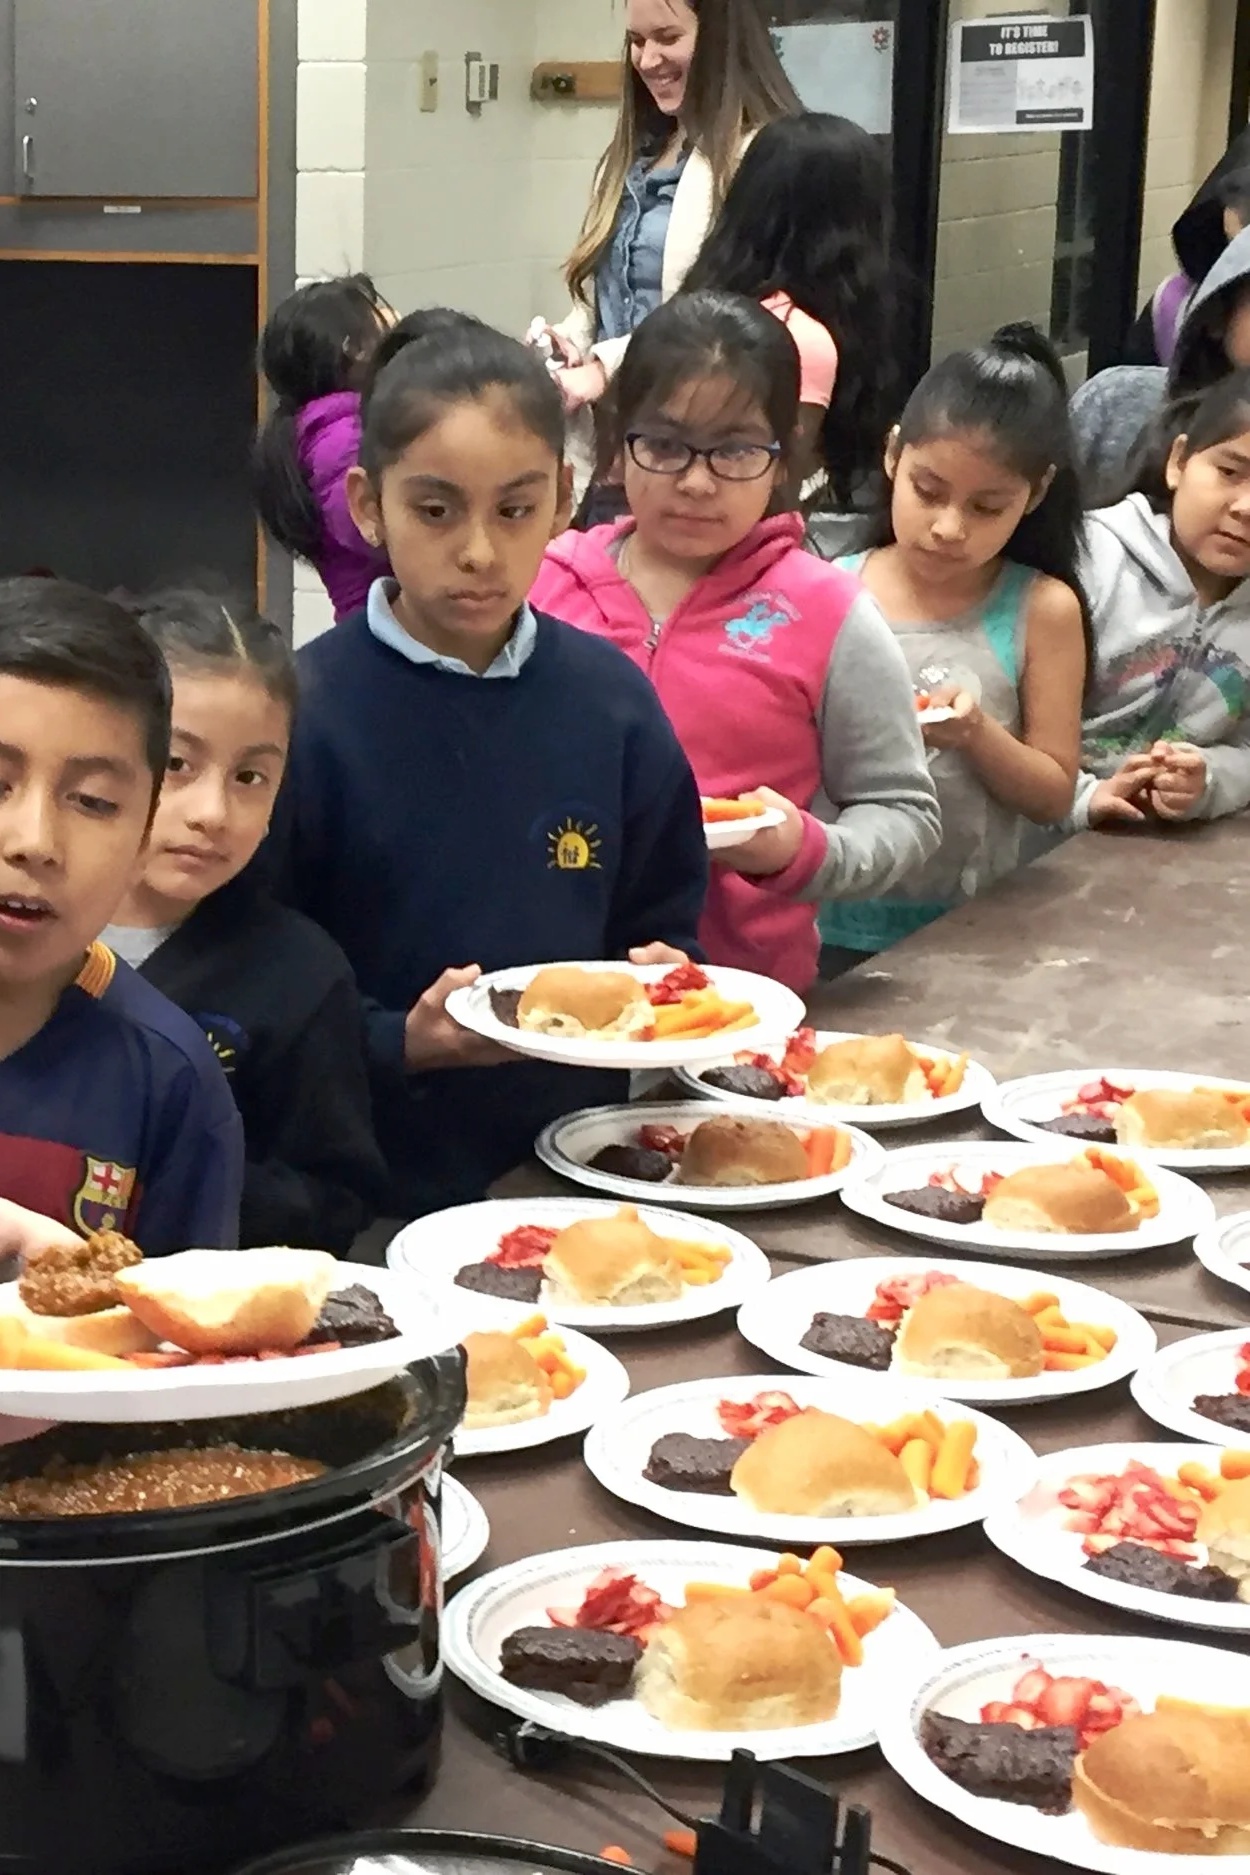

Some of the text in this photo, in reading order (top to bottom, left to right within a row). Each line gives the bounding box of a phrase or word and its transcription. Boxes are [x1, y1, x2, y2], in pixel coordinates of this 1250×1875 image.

[1000, 25, 1048, 39] IT'S TIME
[989, 40, 1059, 55] TO REGISTER!
